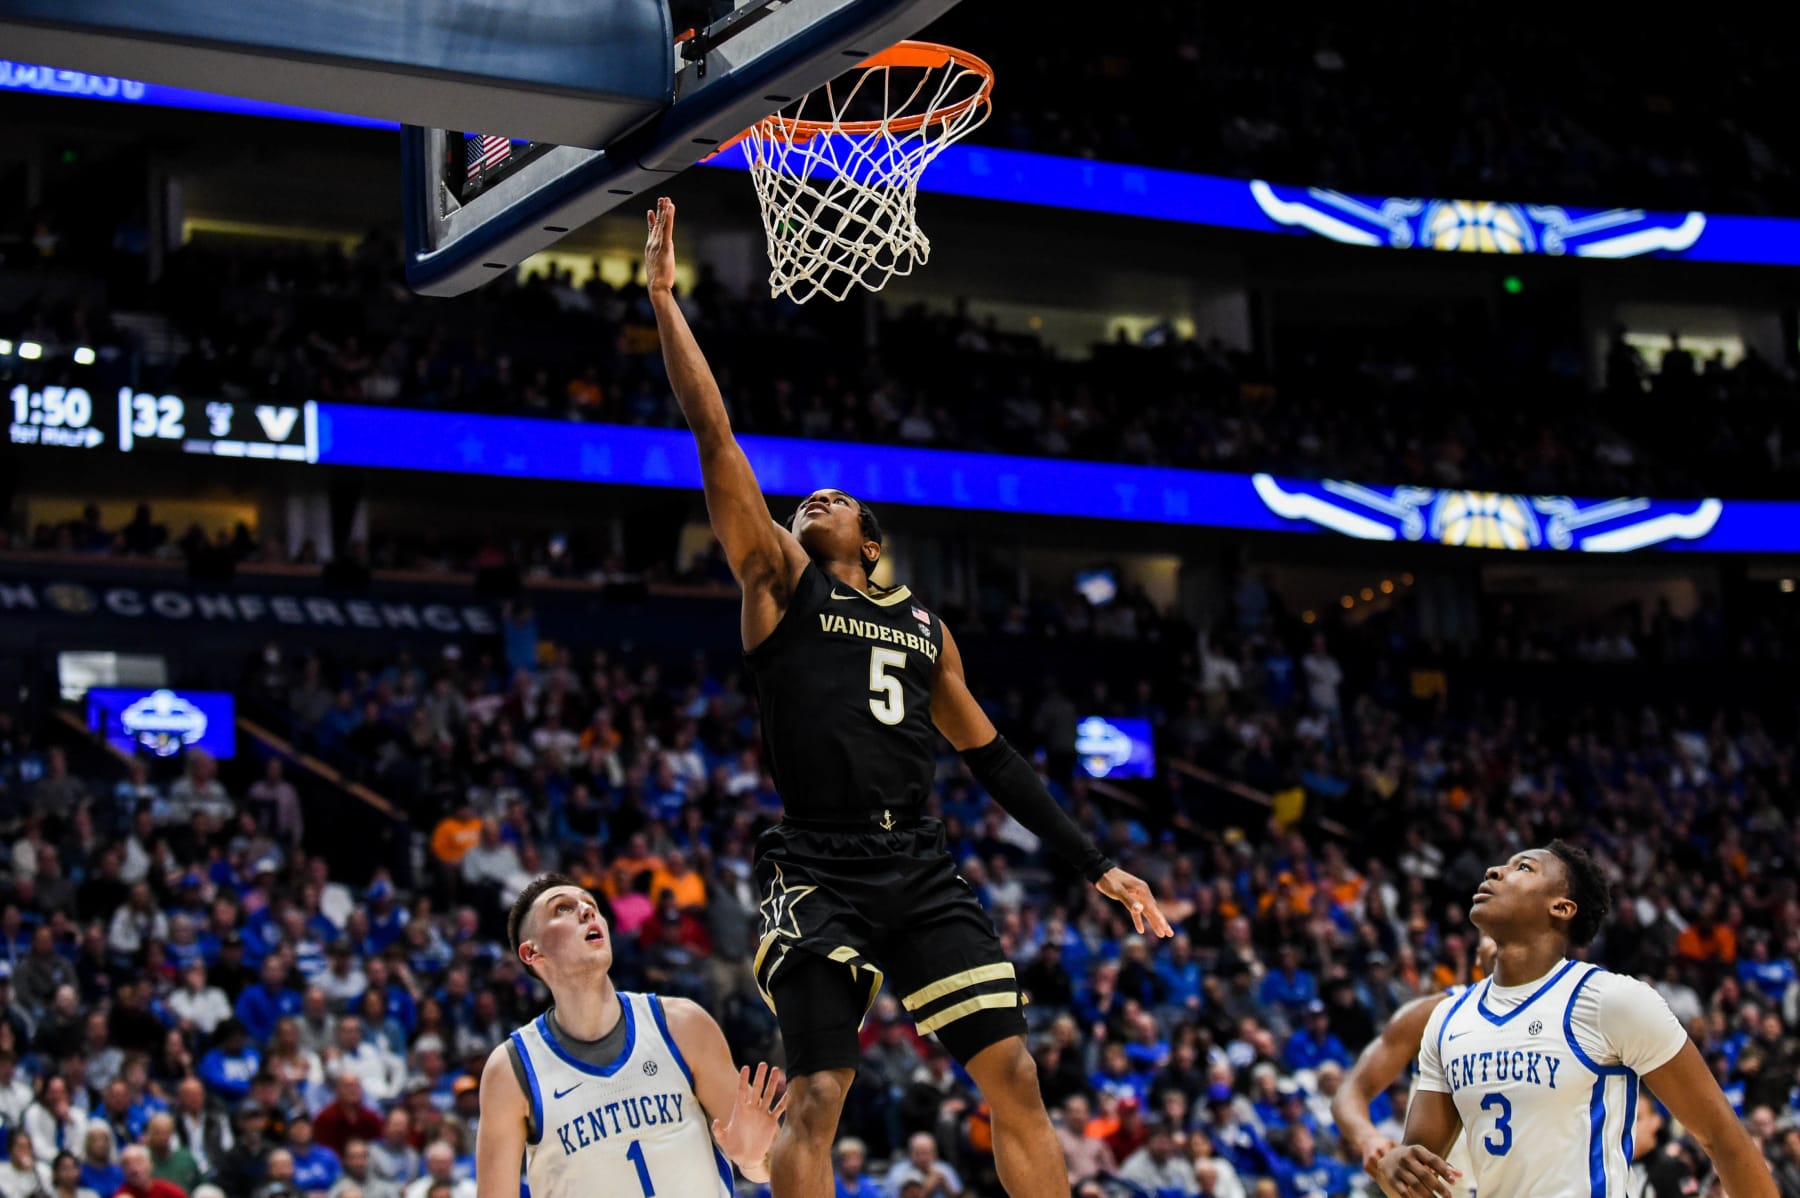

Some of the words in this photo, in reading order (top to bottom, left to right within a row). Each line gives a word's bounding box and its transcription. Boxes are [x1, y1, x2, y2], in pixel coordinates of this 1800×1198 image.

[10, 384, 92, 428] 1:50
[133, 394, 184, 439] 32
[582, 441, 1022, 507] NAHVILLE
[104, 588, 497, 635] CONFERENCE
[818, 613, 938, 664] VANDERBILT
[868, 645, 908, 726] 5
[556, 1092, 685, 1157] KENTUCKY
[1480, 1091, 1513, 1157] 3
[626, 1139, 656, 1198] 1
